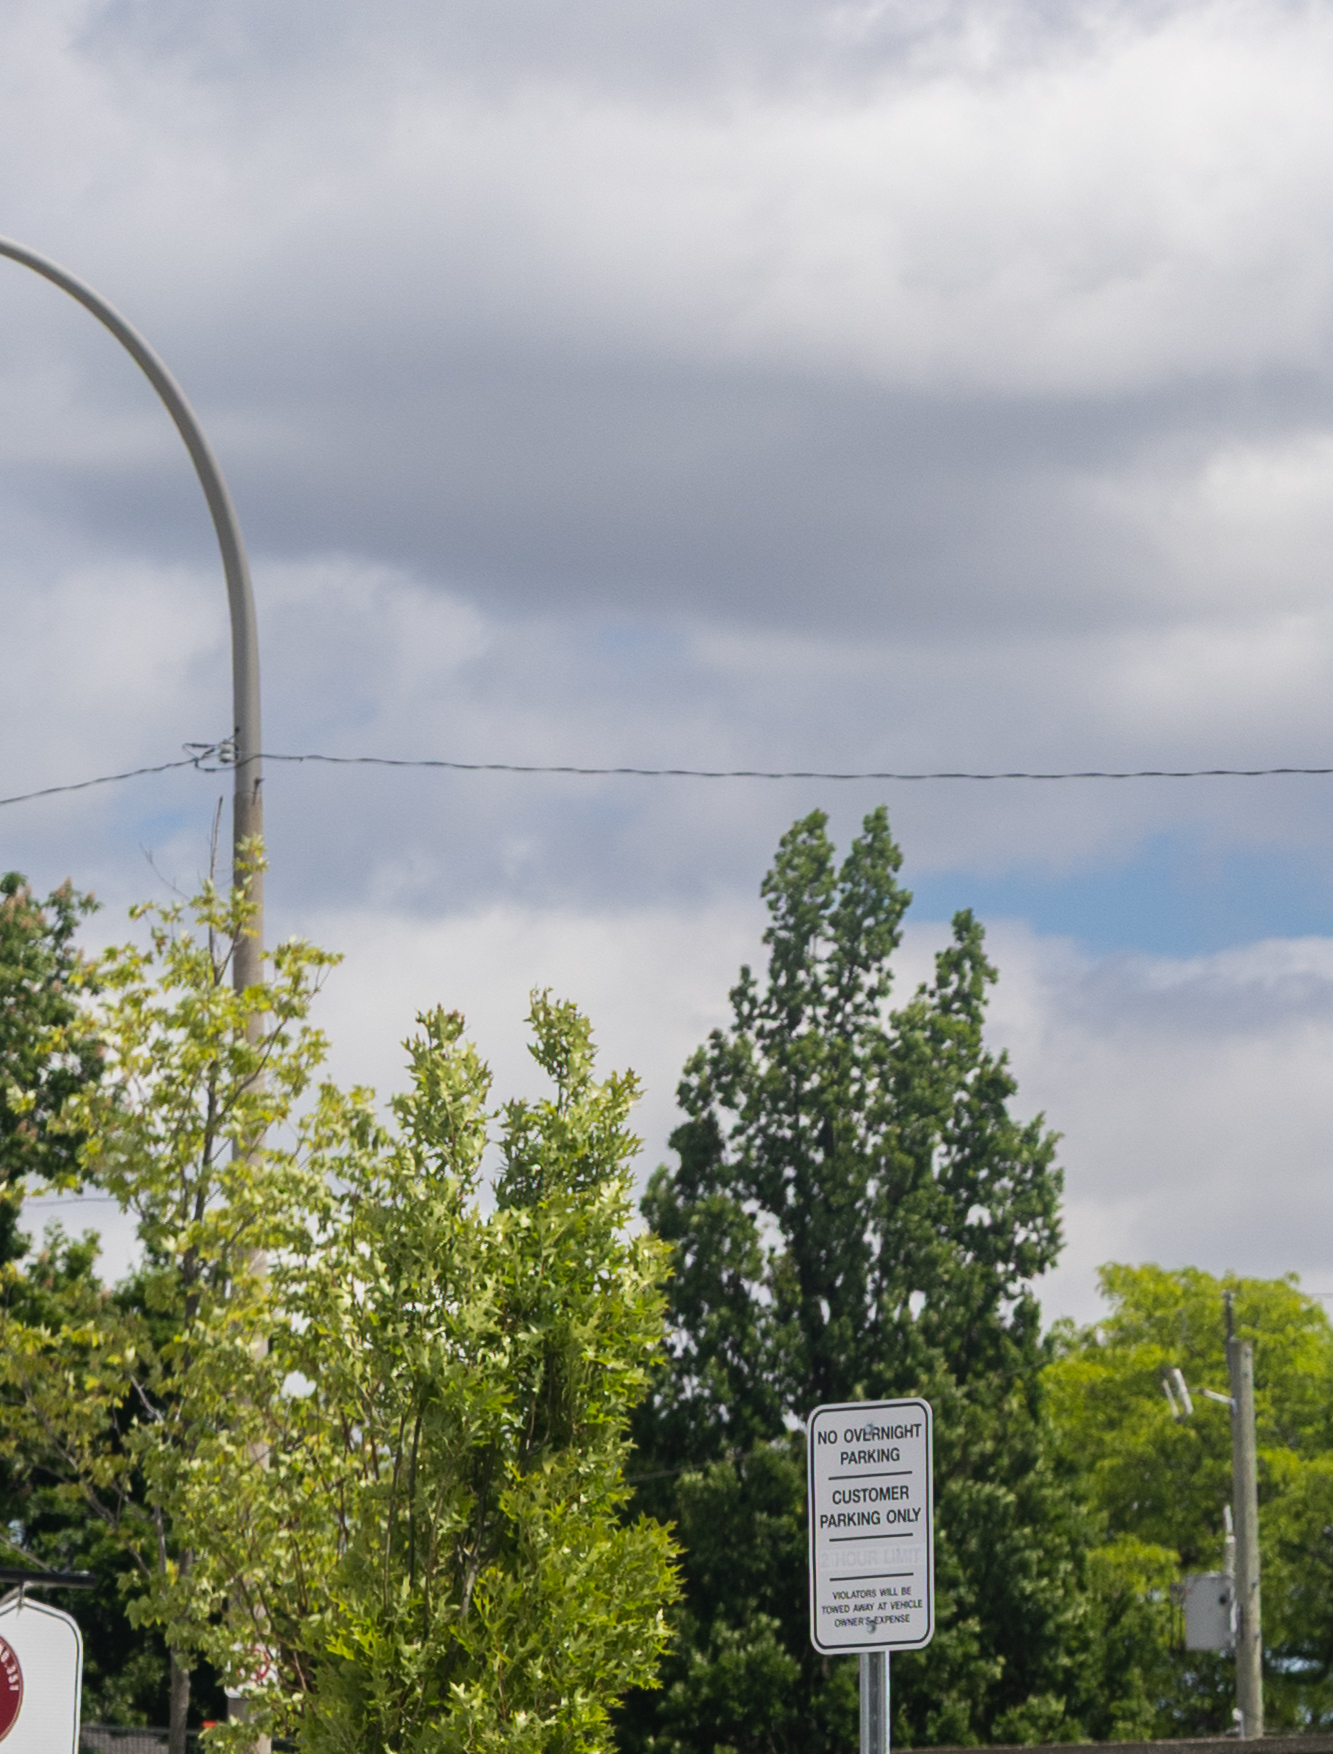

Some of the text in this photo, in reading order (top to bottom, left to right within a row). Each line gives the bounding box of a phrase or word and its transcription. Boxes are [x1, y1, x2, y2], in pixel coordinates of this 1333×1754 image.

[817, 1423, 922, 1445] NO OVERNIGHT
[840, 1448, 900, 1465] PARKING
[832, 1485, 910, 1504] CUSTOMER
[820, 1507, 921, 1529] PARKING ONLY
[832, 1586, 911, 1600] VIOLATORS WILL BE
[821, 1599, 923, 1615] TOWED AWAY AT VEHICLE
[873, 1614, 911, 1625] EXPENSE
